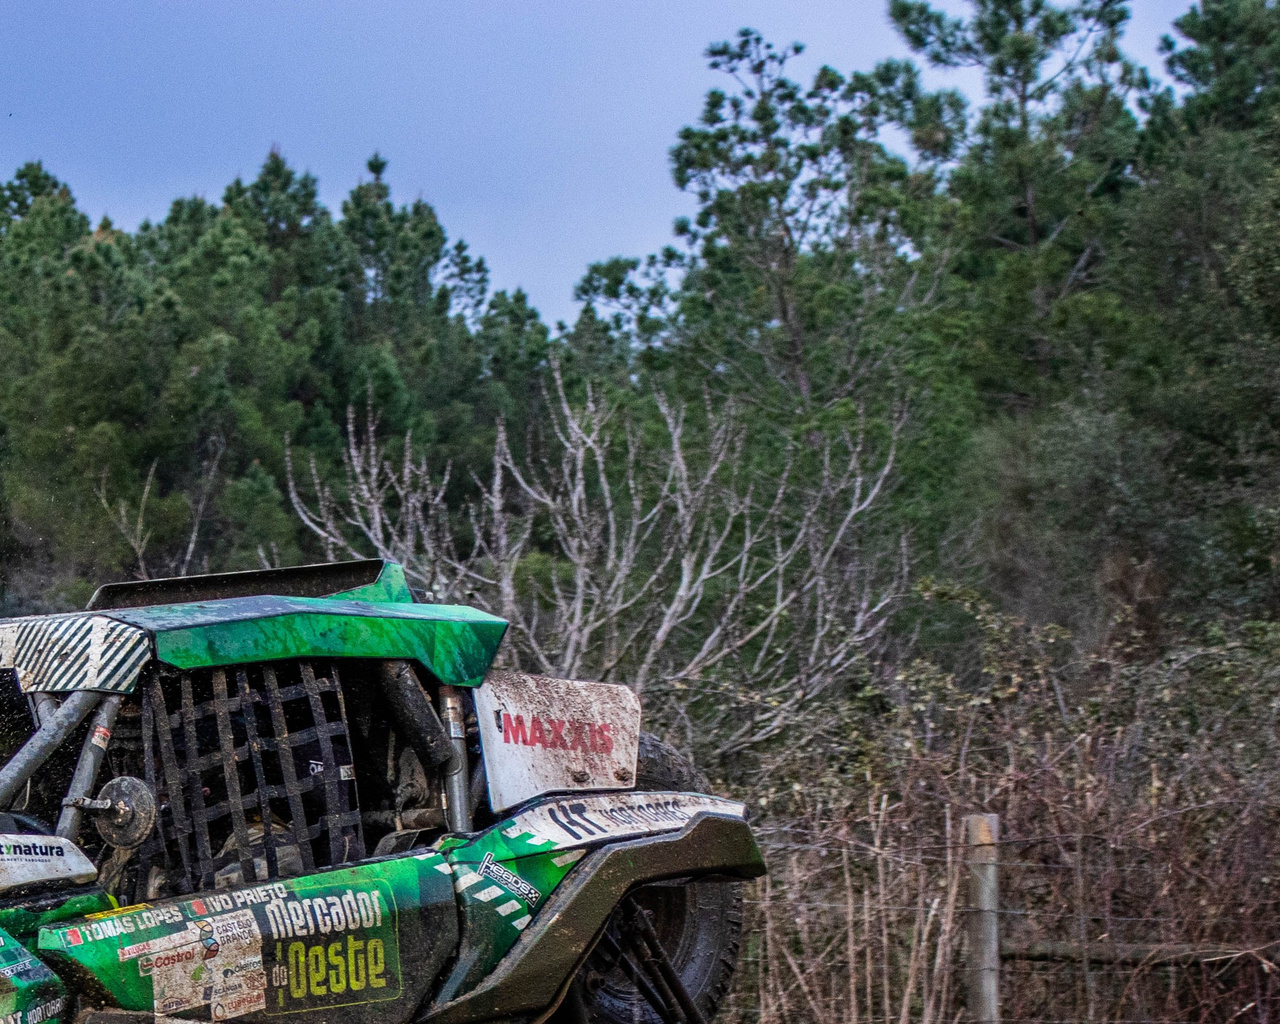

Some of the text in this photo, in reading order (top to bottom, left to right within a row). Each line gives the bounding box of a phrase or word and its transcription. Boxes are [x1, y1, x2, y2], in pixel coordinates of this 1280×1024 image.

[502, 712, 614, 755] MAXXIS
[598, 800, 690, 828] HORTORRES
[206, 882, 288, 914] IVO PRIETO
[136, 904, 184, 931] LOPES
[216, 918, 253, 935] CASTELO
[265, 889, 382, 940] Mercador
[219, 929, 254, 947] BRANCO
[154, 948, 196, 969] Castrol
[272, 934, 387, 999] do Oeste
